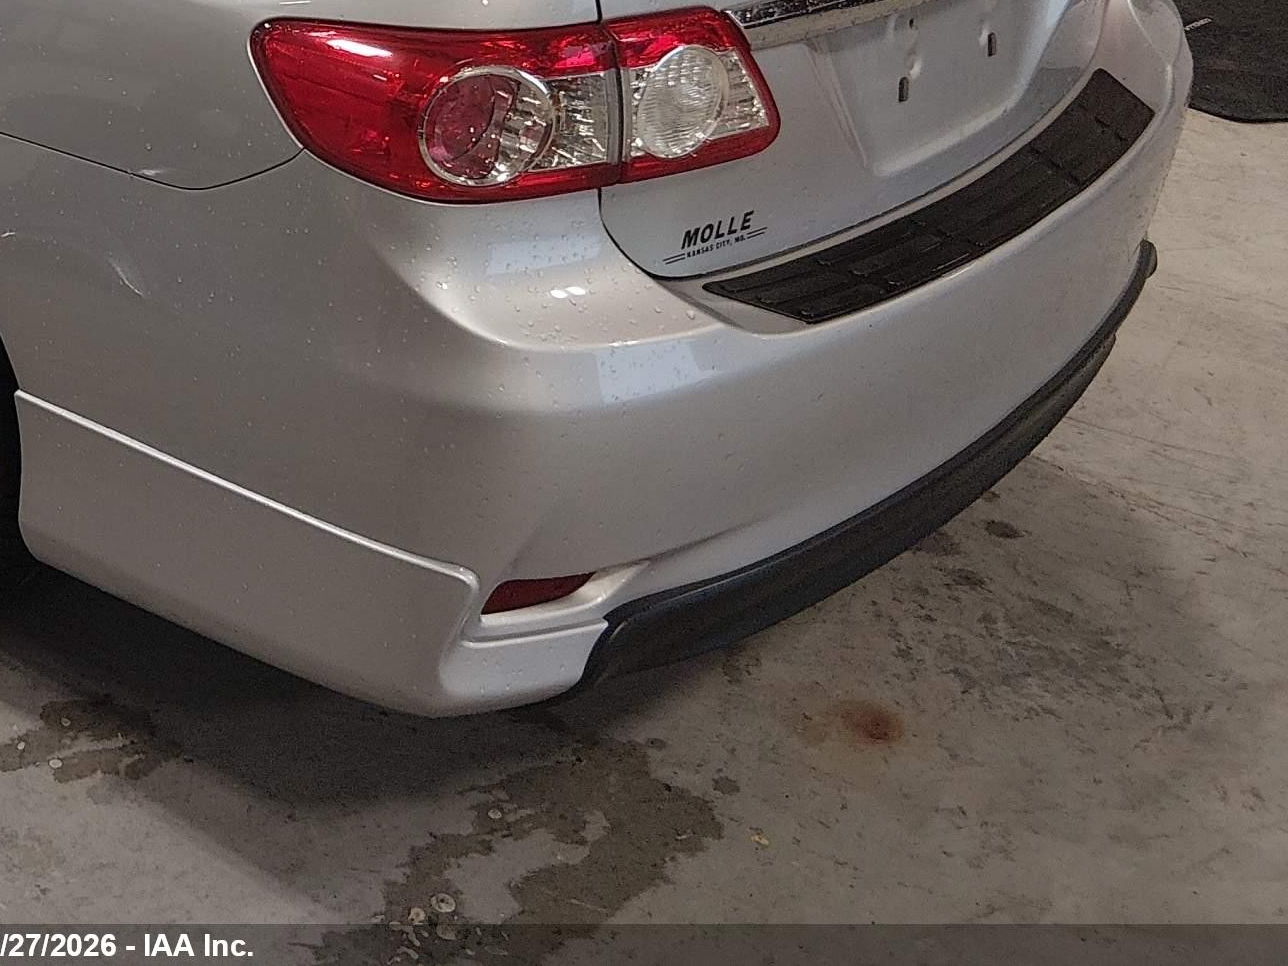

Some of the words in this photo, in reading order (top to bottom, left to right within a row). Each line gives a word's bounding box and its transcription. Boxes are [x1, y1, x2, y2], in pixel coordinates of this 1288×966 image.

[681, 210, 754, 249] MOLLE
[687, 244, 714, 258] KANSAS
[734, 235, 746, 244] MO.
